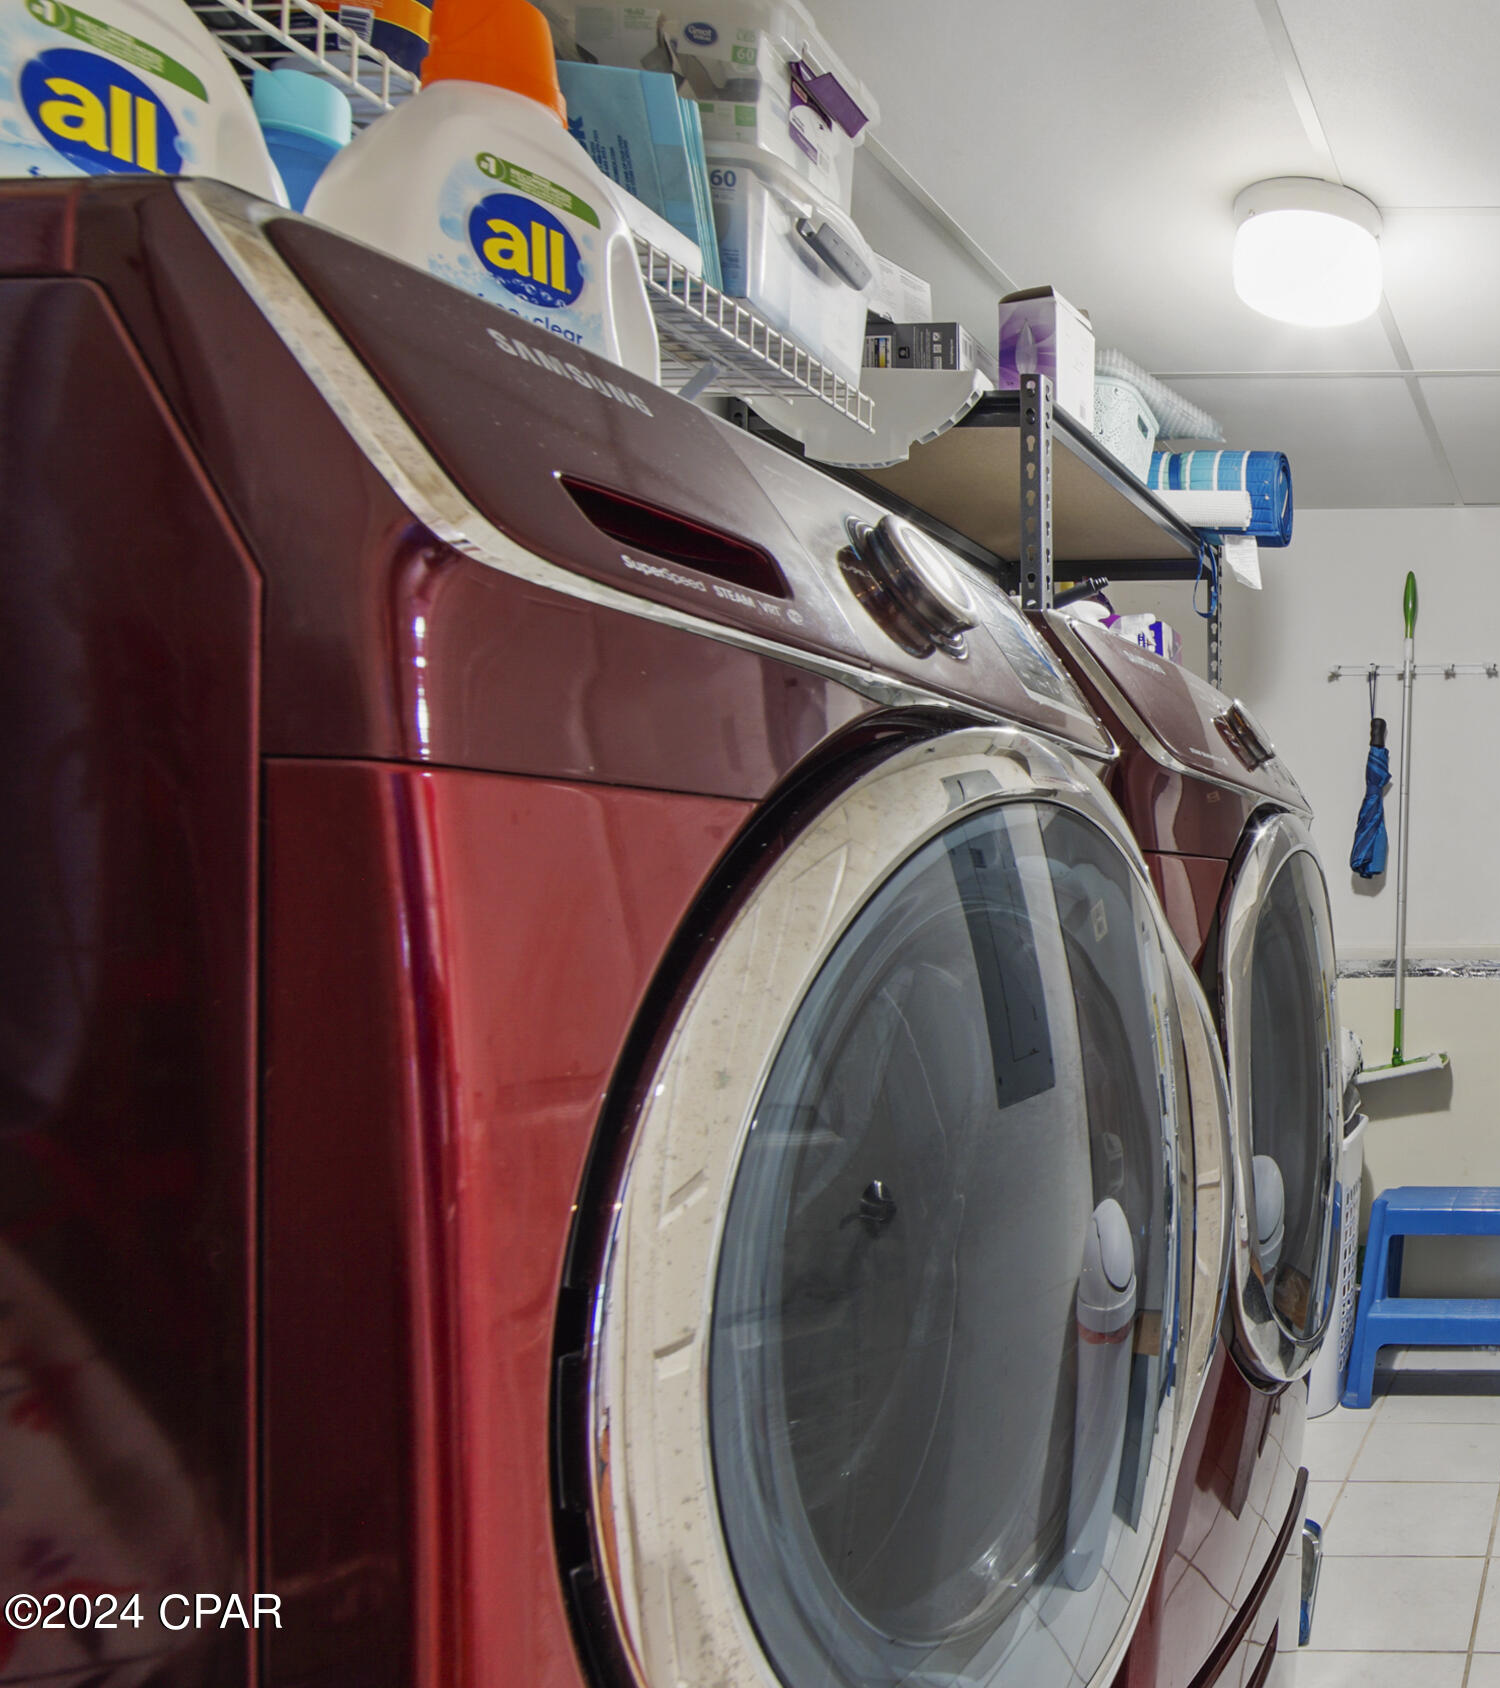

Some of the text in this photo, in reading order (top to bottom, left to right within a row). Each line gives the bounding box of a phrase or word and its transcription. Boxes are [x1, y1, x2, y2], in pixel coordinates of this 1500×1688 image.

[736, 48, 756, 61] 60
[39, 77, 157, 173] all
[710, 169, 736, 187] 60
[483, 219, 566, 293] all
[486, 327, 654, 418] SAMSUNG
[620, 554, 708, 593] SuperSpeed
[712, 584, 757, 609] STEAM
